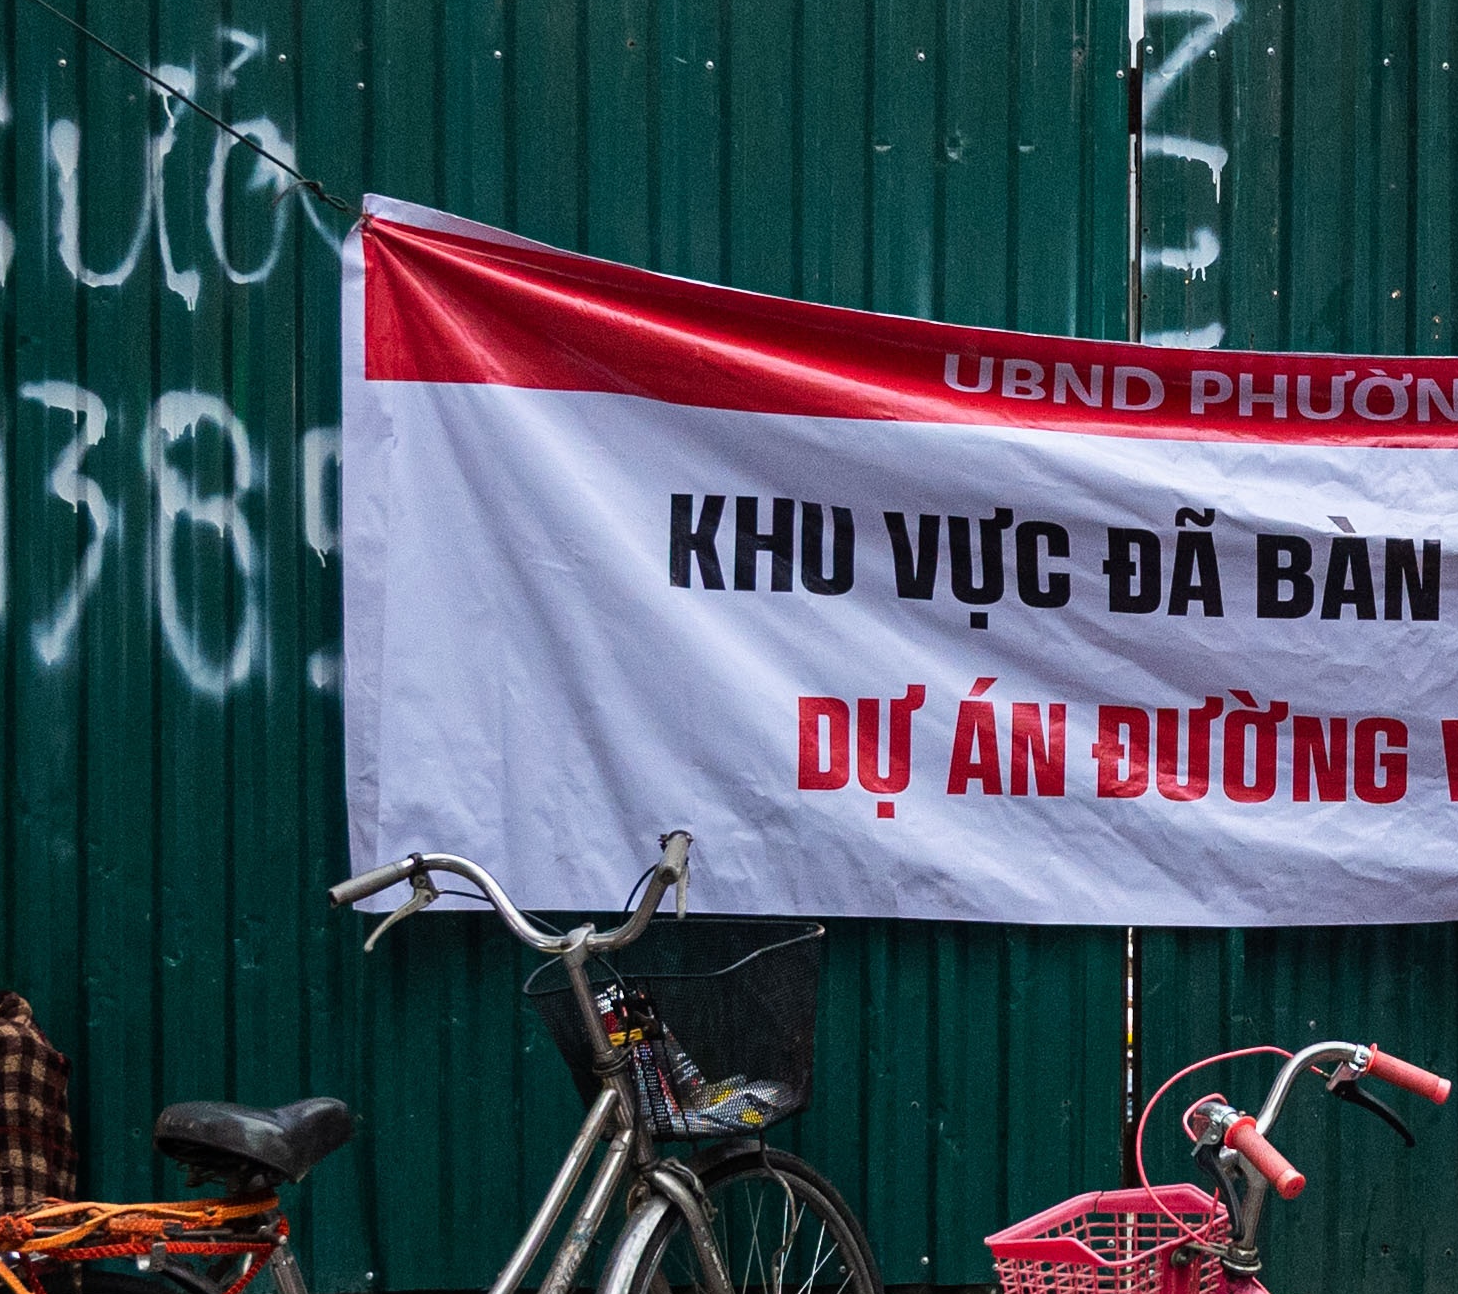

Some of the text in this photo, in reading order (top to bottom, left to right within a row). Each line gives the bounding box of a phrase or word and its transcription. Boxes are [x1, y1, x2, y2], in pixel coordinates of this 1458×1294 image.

[943, 359, 1160, 412] UBND
[668, 492, 856, 597] KHU
[882, 505, 1073, 632] VỰC
[1102, 505, 1236, 619] ĐÃ
[1256, 512, 1443, 623] BÀN
[797, 682, 927, 820] DỰ
[947, 675, 1068, 797] ÁN
[1090, 692, 1409, 805] ĐƯỜNG
